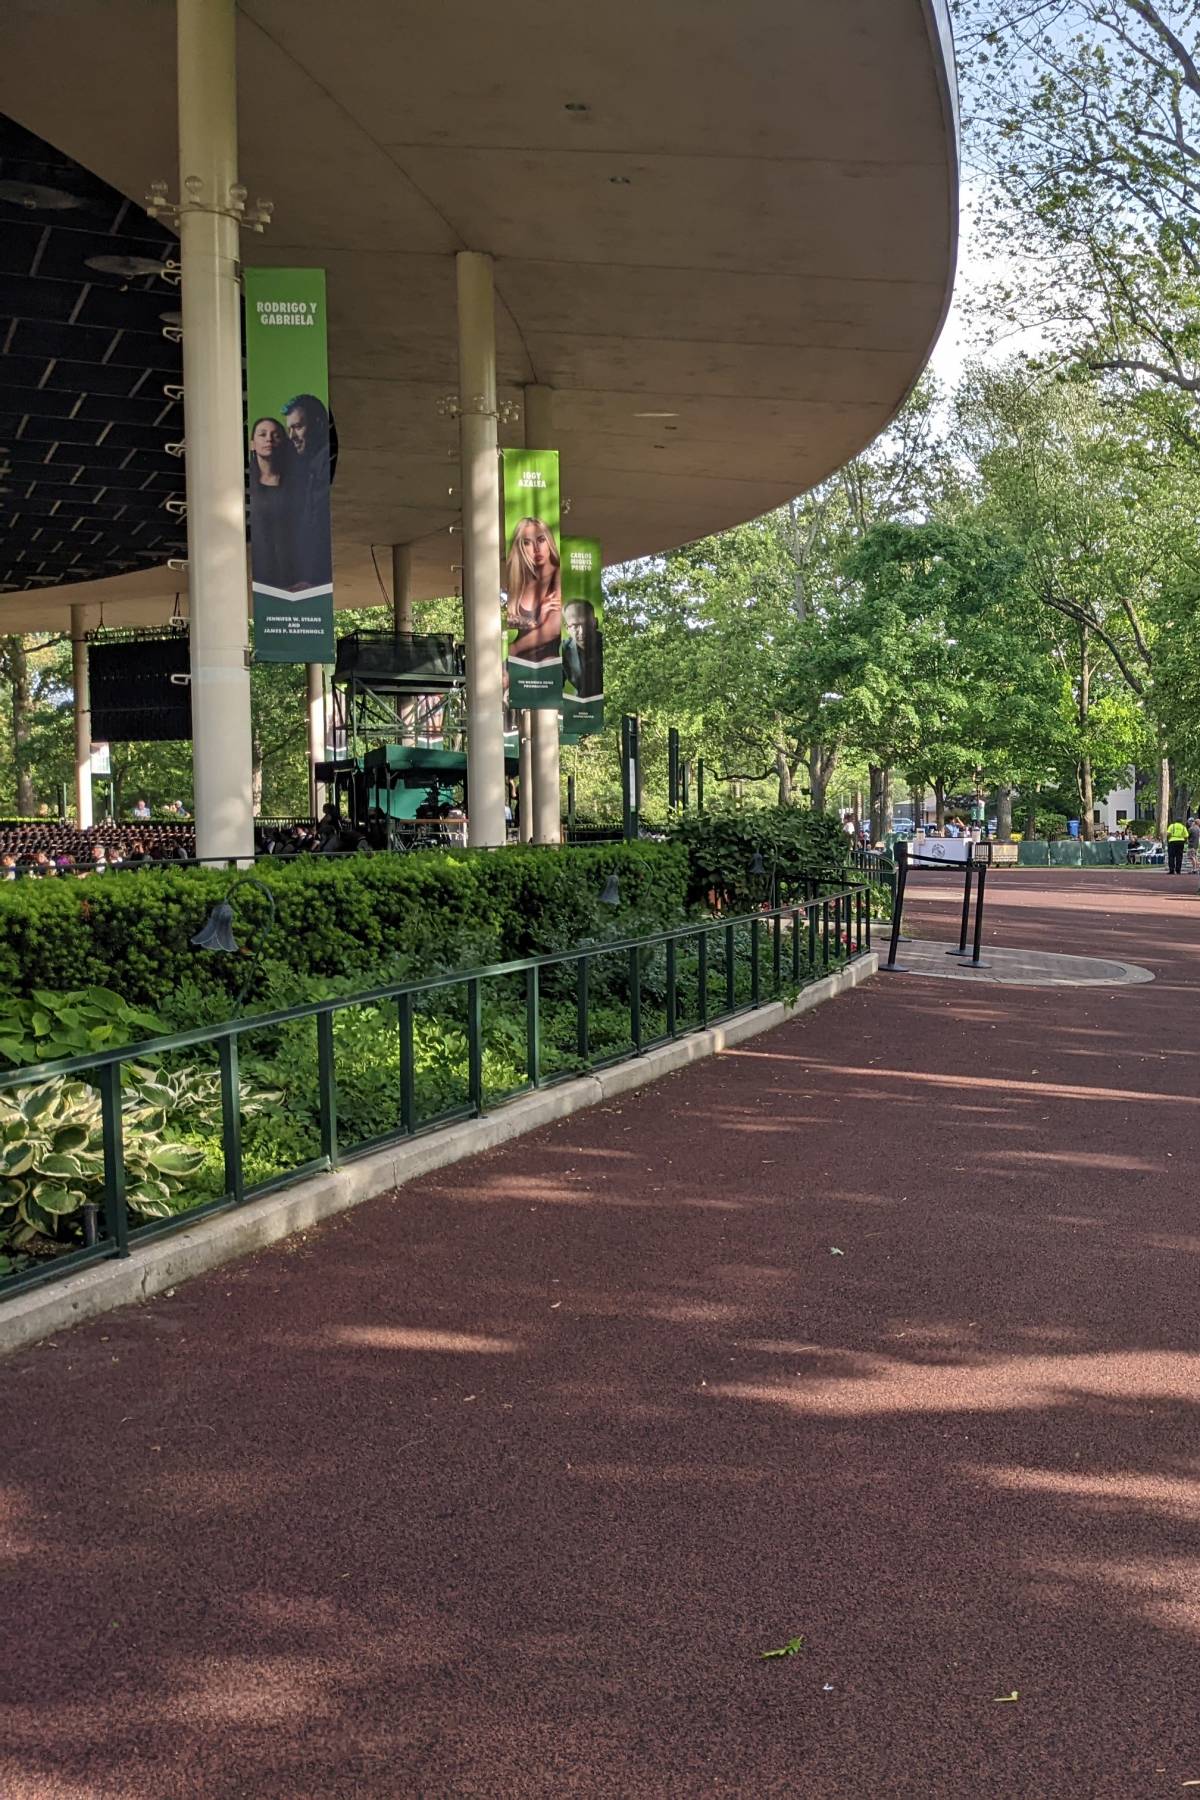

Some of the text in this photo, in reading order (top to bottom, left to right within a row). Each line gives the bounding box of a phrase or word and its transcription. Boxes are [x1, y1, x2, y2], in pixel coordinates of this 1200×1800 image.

[256, 302, 318, 313] RODRIGO Y
[260, 314, 314, 326] GABRIELA
[523, 471, 542, 480] IGGY
[518, 479, 546, 488] AZALEA
